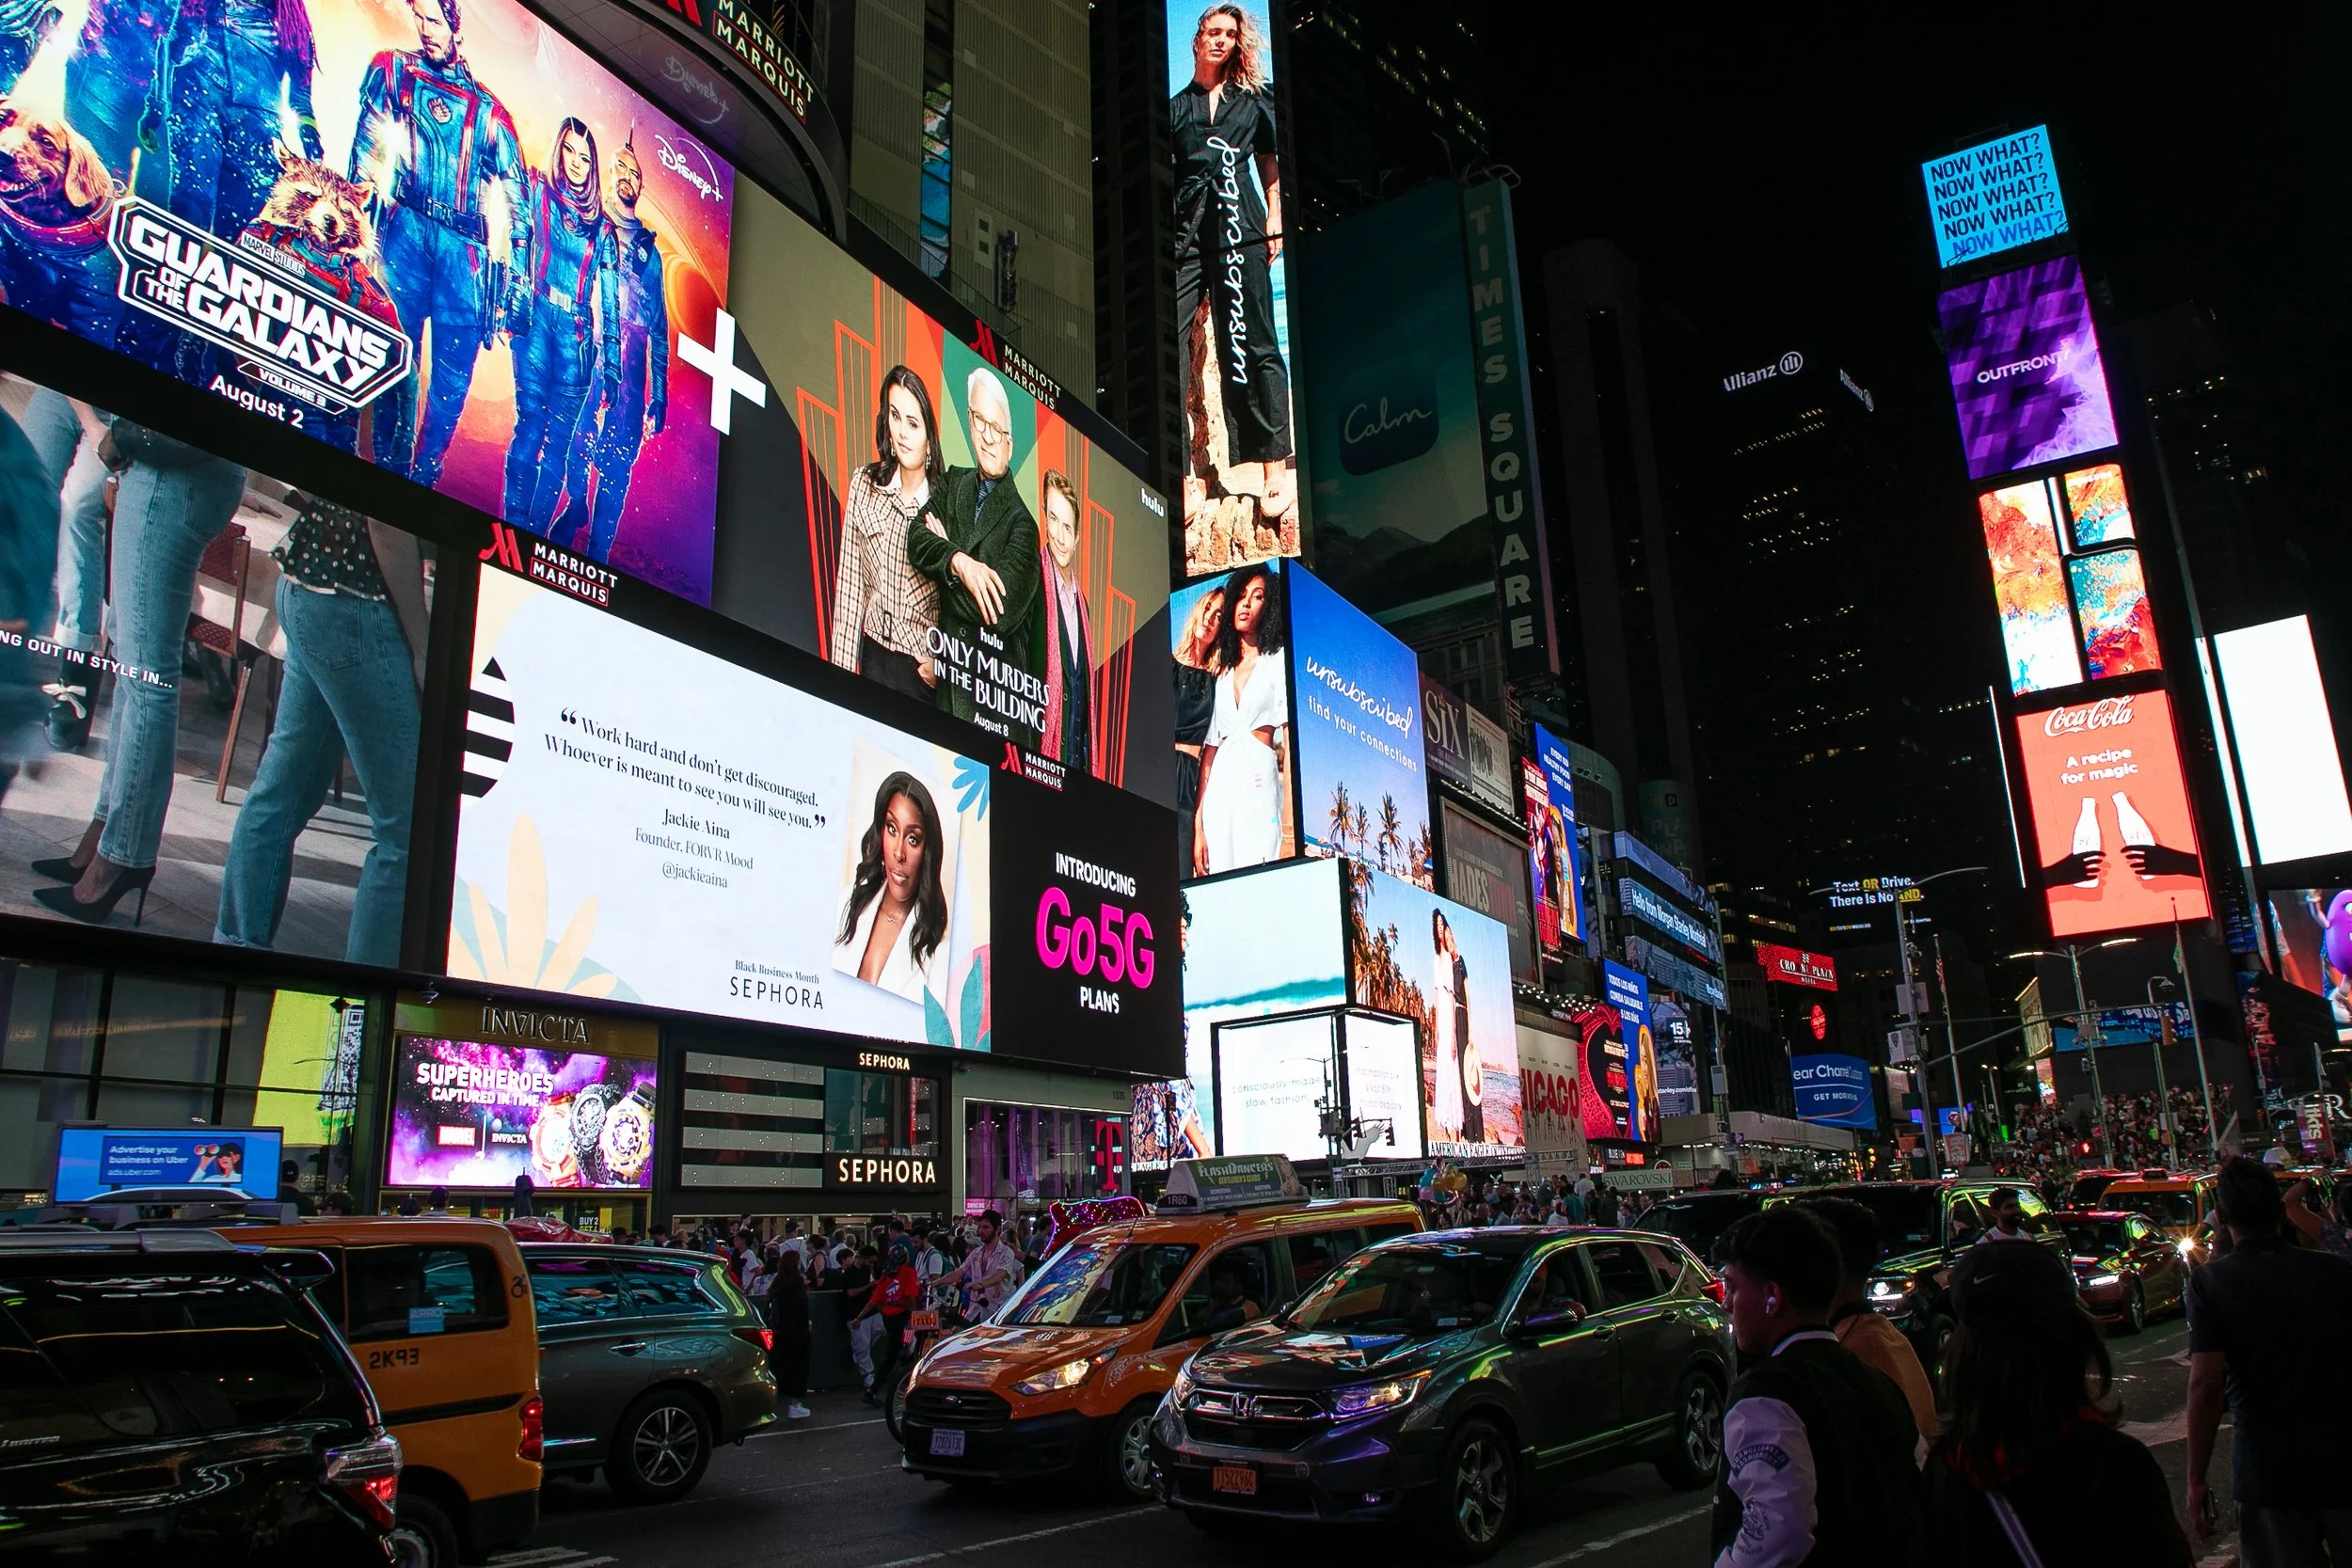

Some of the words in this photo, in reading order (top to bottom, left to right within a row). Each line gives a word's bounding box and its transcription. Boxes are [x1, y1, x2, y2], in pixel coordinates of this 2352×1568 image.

[717, 19, 804, 117] MARQUIS
[719, 0, 813, 103] MARRIOTT
[1930, 154, 1972, 182] NOW
[1974, 134, 2041, 166] WHAT?
[1933, 173, 1975, 201] NOW
[1978, 152, 2044, 186] WHAT?
[1937, 194, 1979, 221] NOW
[1982, 172, 2048, 206] WHAT?
[1944, 213, 1985, 241] NOW
[1989, 191, 2055, 226] WHAT?
[1952, 231, 1994, 258] NOW
[1997, 210, 2063, 245] WHAT?
[243, 232, 273, 260] MARVEL
[273, 247, 306, 277] STUDIOS
[1206, 135, 1248, 384] unsubscribed
[129, 214, 391, 367] GUARDIANS
[143, 277, 186, 313] THE
[159, 268, 191, 292] OF
[186, 283, 379, 392] GALAXY
[258, 368, 315, 402] VOLUME
[315, 394, 326, 406] 3
[1004, 344, 1061, 399] MARRIOTT
[1004, 362, 1056, 411] MARQUIS
[1723, 365, 1777, 392] Allianz
[210, 374, 284, 420] August
[292, 410, 304, 429] 2
[1343, 396, 1433, 445] Calm
[1470, 205, 1508, 384] TIMES
[1490, 412, 1534, 649] SQUARE
[1139, 488, 1165, 517] hulu
[532, 562, 608, 605] MARQUIS
[533, 542, 619, 589] MARRIOTT
[979, 627, 1004, 650] hulu
[27, 639, 61, 657] OUT
[66, 649, 85, 664] IN
[89, 656, 138, 679] STYLE
[926, 626, 974, 664] ONLY
[977, 649, 1050, 705] MURDERS
[933, 658, 946, 680] IN
[948, 664, 972, 691] THE
[975, 678, 1046, 733] BUILDING
[1306, 656, 1414, 739] unsubscribed
[974, 713, 1002, 736] August
[1003, 724, 1009, 737] 8
[1308, 695, 1330, 721] find
[1332, 714, 1357, 736] your
[1360, 730, 1418, 772] connections
[2043, 695, 2135, 738] Coca-Cola
[544, 734, 613, 769] Whoever
[616, 756, 628, 774] is
[631, 764, 675, 789] meant
[678, 777, 692, 794] to
[694, 784, 715, 800] see
[717, 788, 740, 808] you
[742, 796, 766, 816] will
[768, 804, 787, 819] see
[625, 732, 658, 756] hard
[660, 743, 687, 766] and
[724, 767, 744, 784] get
[746, 772, 819, 807] discouraged.
[1025, 752, 1066, 777] MARRIOTT
[2060, 771, 2085, 785] for
[2089, 763, 2138, 782] magic
[2066, 755, 2079, 768] A
[2081, 748, 2132, 768] recipe
[1025, 766, 1062, 790] MARQUIS
[662, 808, 700, 833] Jackie
[702, 818, 730, 840] Aina
[662, 861, 728, 889] @jackieaina
[724, 850, 754, 871] Mood
[1056, 851, 1136, 897] INTRODUCING
[1829, 895, 1864, 908] There
[1865, 893, 1876, 904] Is
[1878, 892, 1894, 903] No
[1833, 880, 1861, 893] Text
[1863, 879, 1880, 890] OR
[1881, 876, 1915, 889] Drive.
[1631, 888, 1645, 911] Hello
[1645, 896, 1658, 919] from
[1657, 904, 1675, 928] Morgan
[1674, 914, 1690, 941] Stanley
[1036, 886, 1155, 990] Go5G
[735, 959, 757, 974] Black
[758, 964, 793, 981] Business
[794, 970, 819, 985] Month
[729, 976, 824, 1011] SEPHORA
[1079, 987, 1120, 1014] PLANS
[481, 1006, 591, 1045] INVICTA
[1670, 1022, 1684, 1036] 15
[416, 1062, 554, 1095] SUPERHEROES
[858, 1053, 911, 1070] SEPHORA
[431, 1086, 497, 1106] CAPTURED
[497, 1093, 510, 1106] IN
[512, 1094, 540, 1107] TIME
[1113, 1090, 1126, 1101] 1535
[109, 1145, 155, 1154] Advertise
[156, 1146, 179, 1156] your
[491, 1132, 528, 1145] INVICTA
[1429, 1142, 1469, 1159] AMERICAN
[108, 1155, 151, 1164] business
[166, 1156, 189, 1164] Uber
[838, 1158, 937, 1184] SEPHORA
[1603, 1173, 1672, 1189] SWAROVSKI
[579, 1216, 594, 1226] BUY
[594, 1216, 599, 1226] 2
[369, 1347, 420, 1370] 2K93
